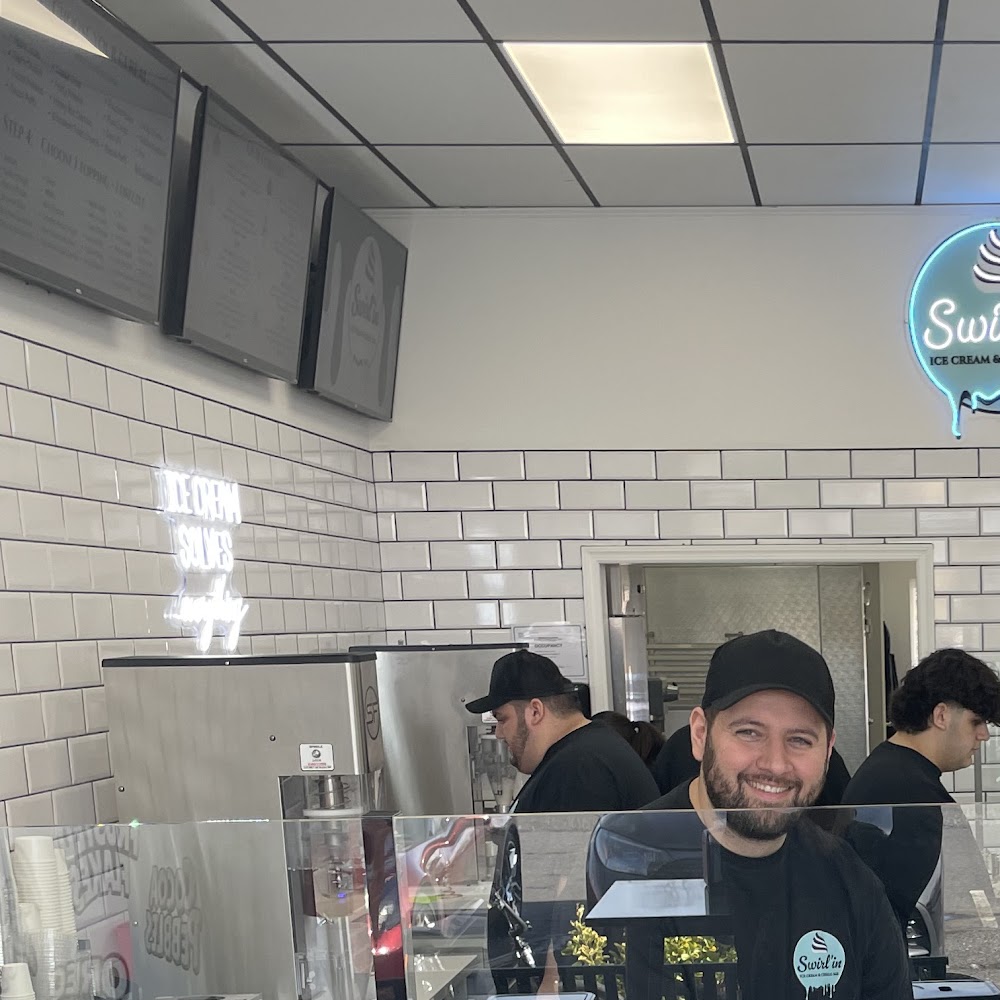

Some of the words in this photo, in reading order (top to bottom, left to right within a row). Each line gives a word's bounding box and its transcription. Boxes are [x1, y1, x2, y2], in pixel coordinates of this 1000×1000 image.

[930, 356, 948, 366] ICE
[951, 355, 990, 366] CREAM
[797, 954, 842, 973] Swirl'in
